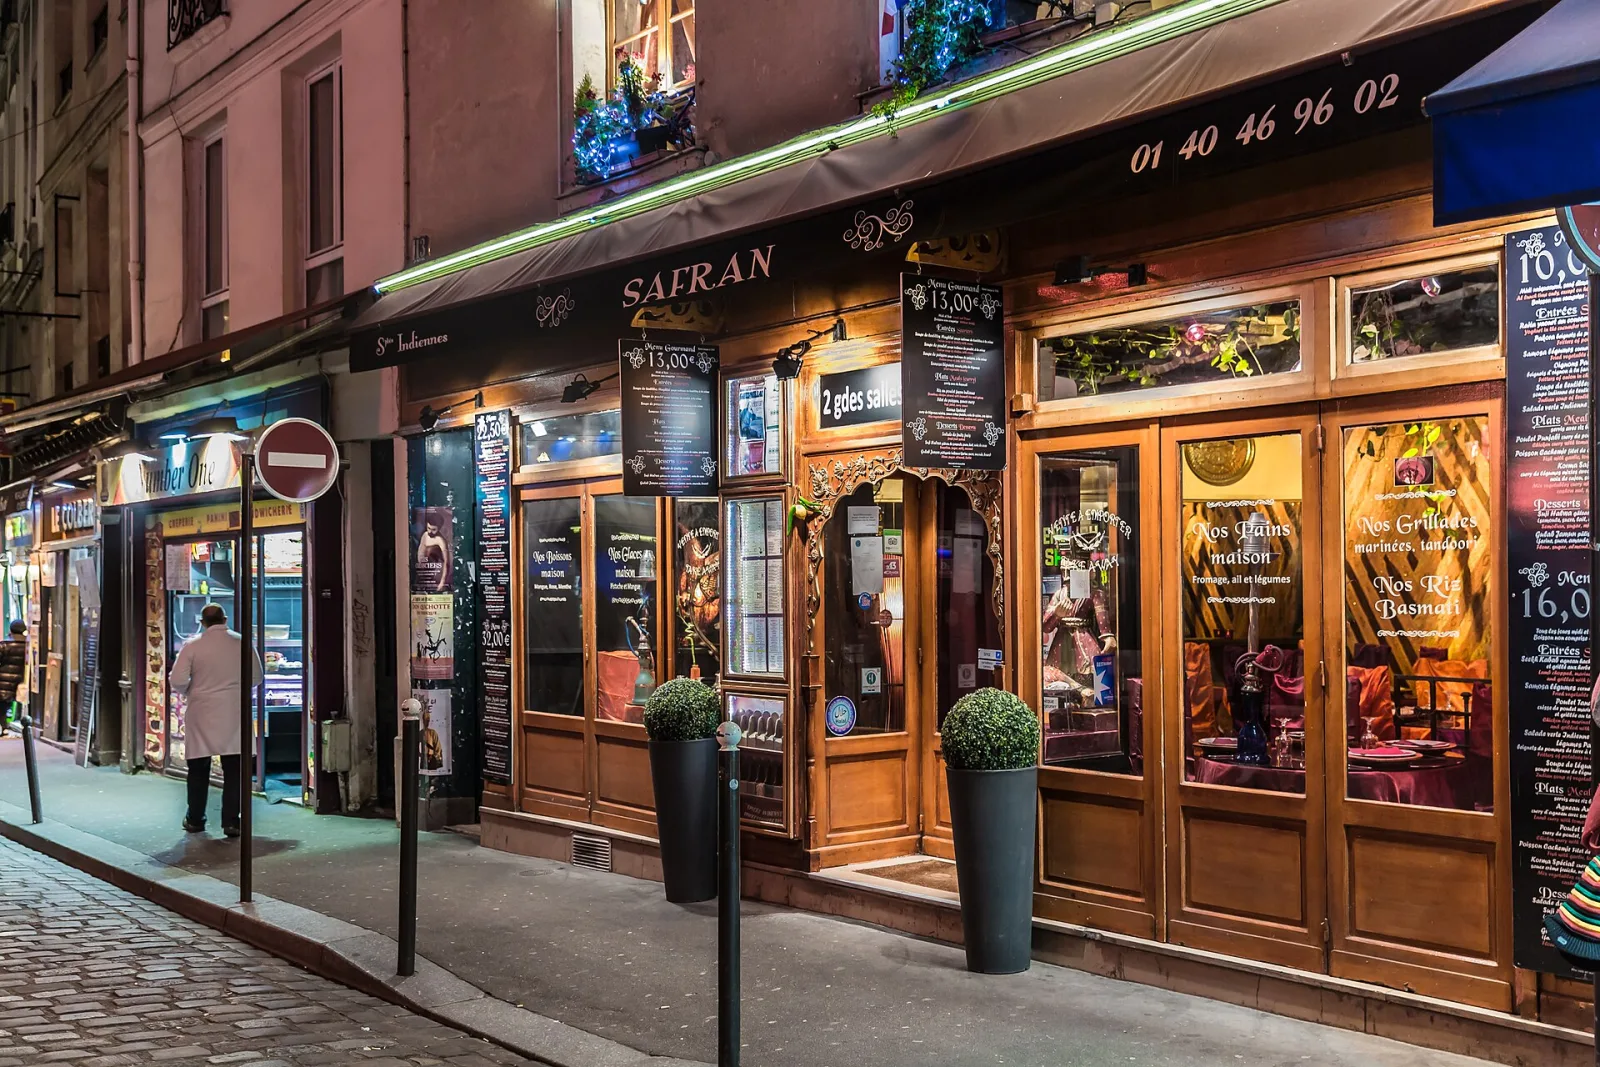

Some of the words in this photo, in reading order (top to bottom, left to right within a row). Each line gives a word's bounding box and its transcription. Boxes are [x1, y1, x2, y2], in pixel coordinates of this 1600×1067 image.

[1131, 141, 1163, 173] 01
[1179, 125, 1218, 160] 40
[1235, 104, 1276, 145] 46
[1294, 87, 1333, 134] 96
[1353, 74, 1399, 114] 02
[623, 244, 776, 308] SAFRAN
[927, 279, 946, 289] Menu
[948, 281, 979, 293] Gourmand
[1536, 306, 1577, 318] Entrées
[397, 331, 448, 353] Indiennes
[645, 343, 663, 351] Menu
[665, 344, 695, 352] Gourmand
[935, 373, 948, 381] Plats
[823, 389, 831, 415] 2
[834, 385, 863, 420] gdes
[1532, 415, 1561, 427] Plats
[138, 459, 185, 495] Number
[188, 453, 215, 488] One
[1533, 499, 1580, 511] Desserts
[207, 512, 227, 523] PANINI
[253, 504, 292, 518] DWICHERIE
[1048, 510, 1076, 535] VENTE
[1078, 509, 1084, 522] A
[1086, 509, 1132, 540] EMPORTER
[1357, 516, 1390, 536] Nos
[1396, 512, 1477, 534] Grillades
[1192, 522, 1228, 543] Nos
[1234, 520, 1290, 544] Pains
[1354, 540, 1416, 553] marinées,
[1420, 535, 1478, 551] tandoori
[533, 552, 545, 564] Nos
[546, 551, 572, 564] Boissons
[608, 547, 621, 561] Nos
[621, 547, 642, 562] Glaces
[1211, 549, 1271, 564] maison
[1089, 554, 1120, 572] AWAY
[541, 568, 564, 577] maison
[615, 566, 635, 578] maison
[1192, 575, 1230, 584] Fromage,
[1232, 575, 1242, 583] ail
[1243, 575, 1253, 583] et
[1254, 574, 1290, 585] légumes
[1558, 571, 1590, 586] Men
[1373, 576, 1413, 597] Nos
[1420, 575, 1461, 598] Riz
[1375, 599, 1460, 619] Basmati
[1522, 587, 1590, 624] 16,0
[1538, 644, 1580, 655] Entrées
[1525, 682, 1549, 690] Samosa
[1535, 782, 1564, 794] Plats
[1519, 840, 1542, 849] Poisson
[1531, 856, 1551, 864] Korma
[1552, 859, 1575, 867] Spécial
